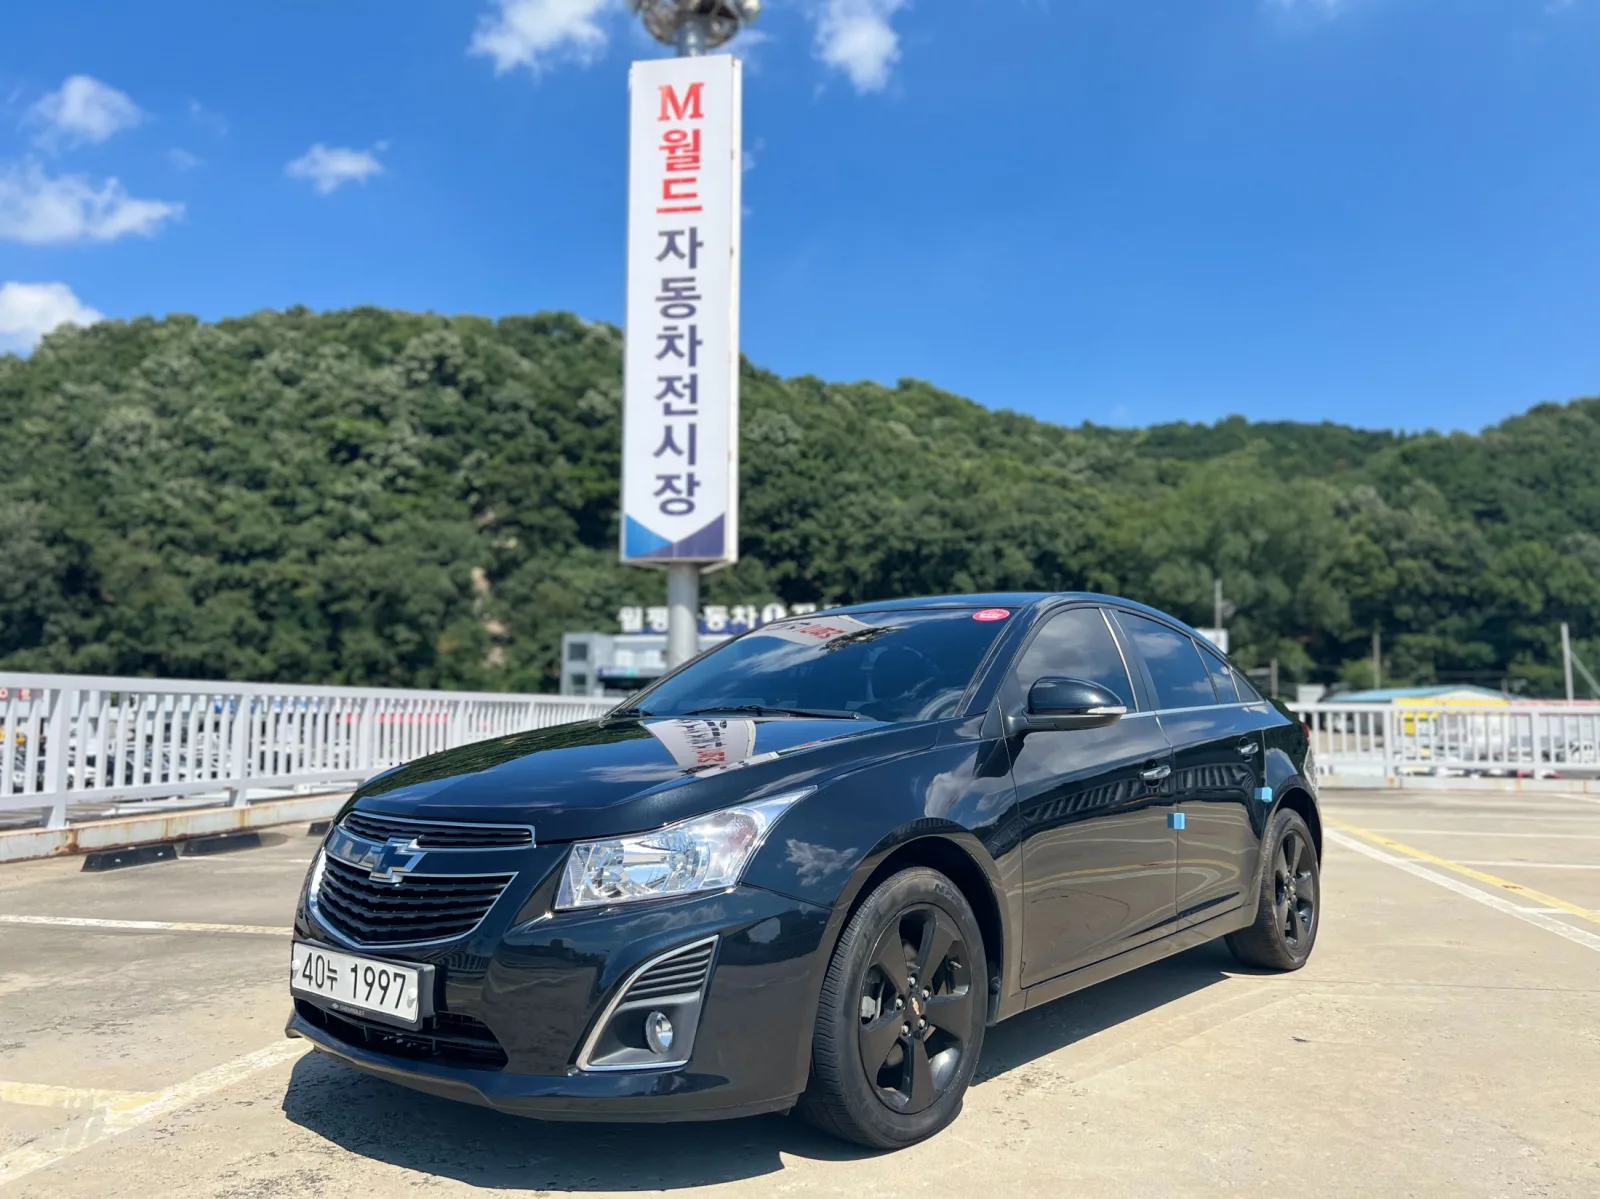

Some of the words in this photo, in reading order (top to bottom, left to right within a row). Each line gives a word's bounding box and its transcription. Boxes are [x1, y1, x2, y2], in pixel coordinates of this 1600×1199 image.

[657, 82, 704, 214] M월드
[653, 226, 704, 516] 자동차전시장
[302, 952, 338, 991] 40누
[350, 963, 407, 1009] 1997
